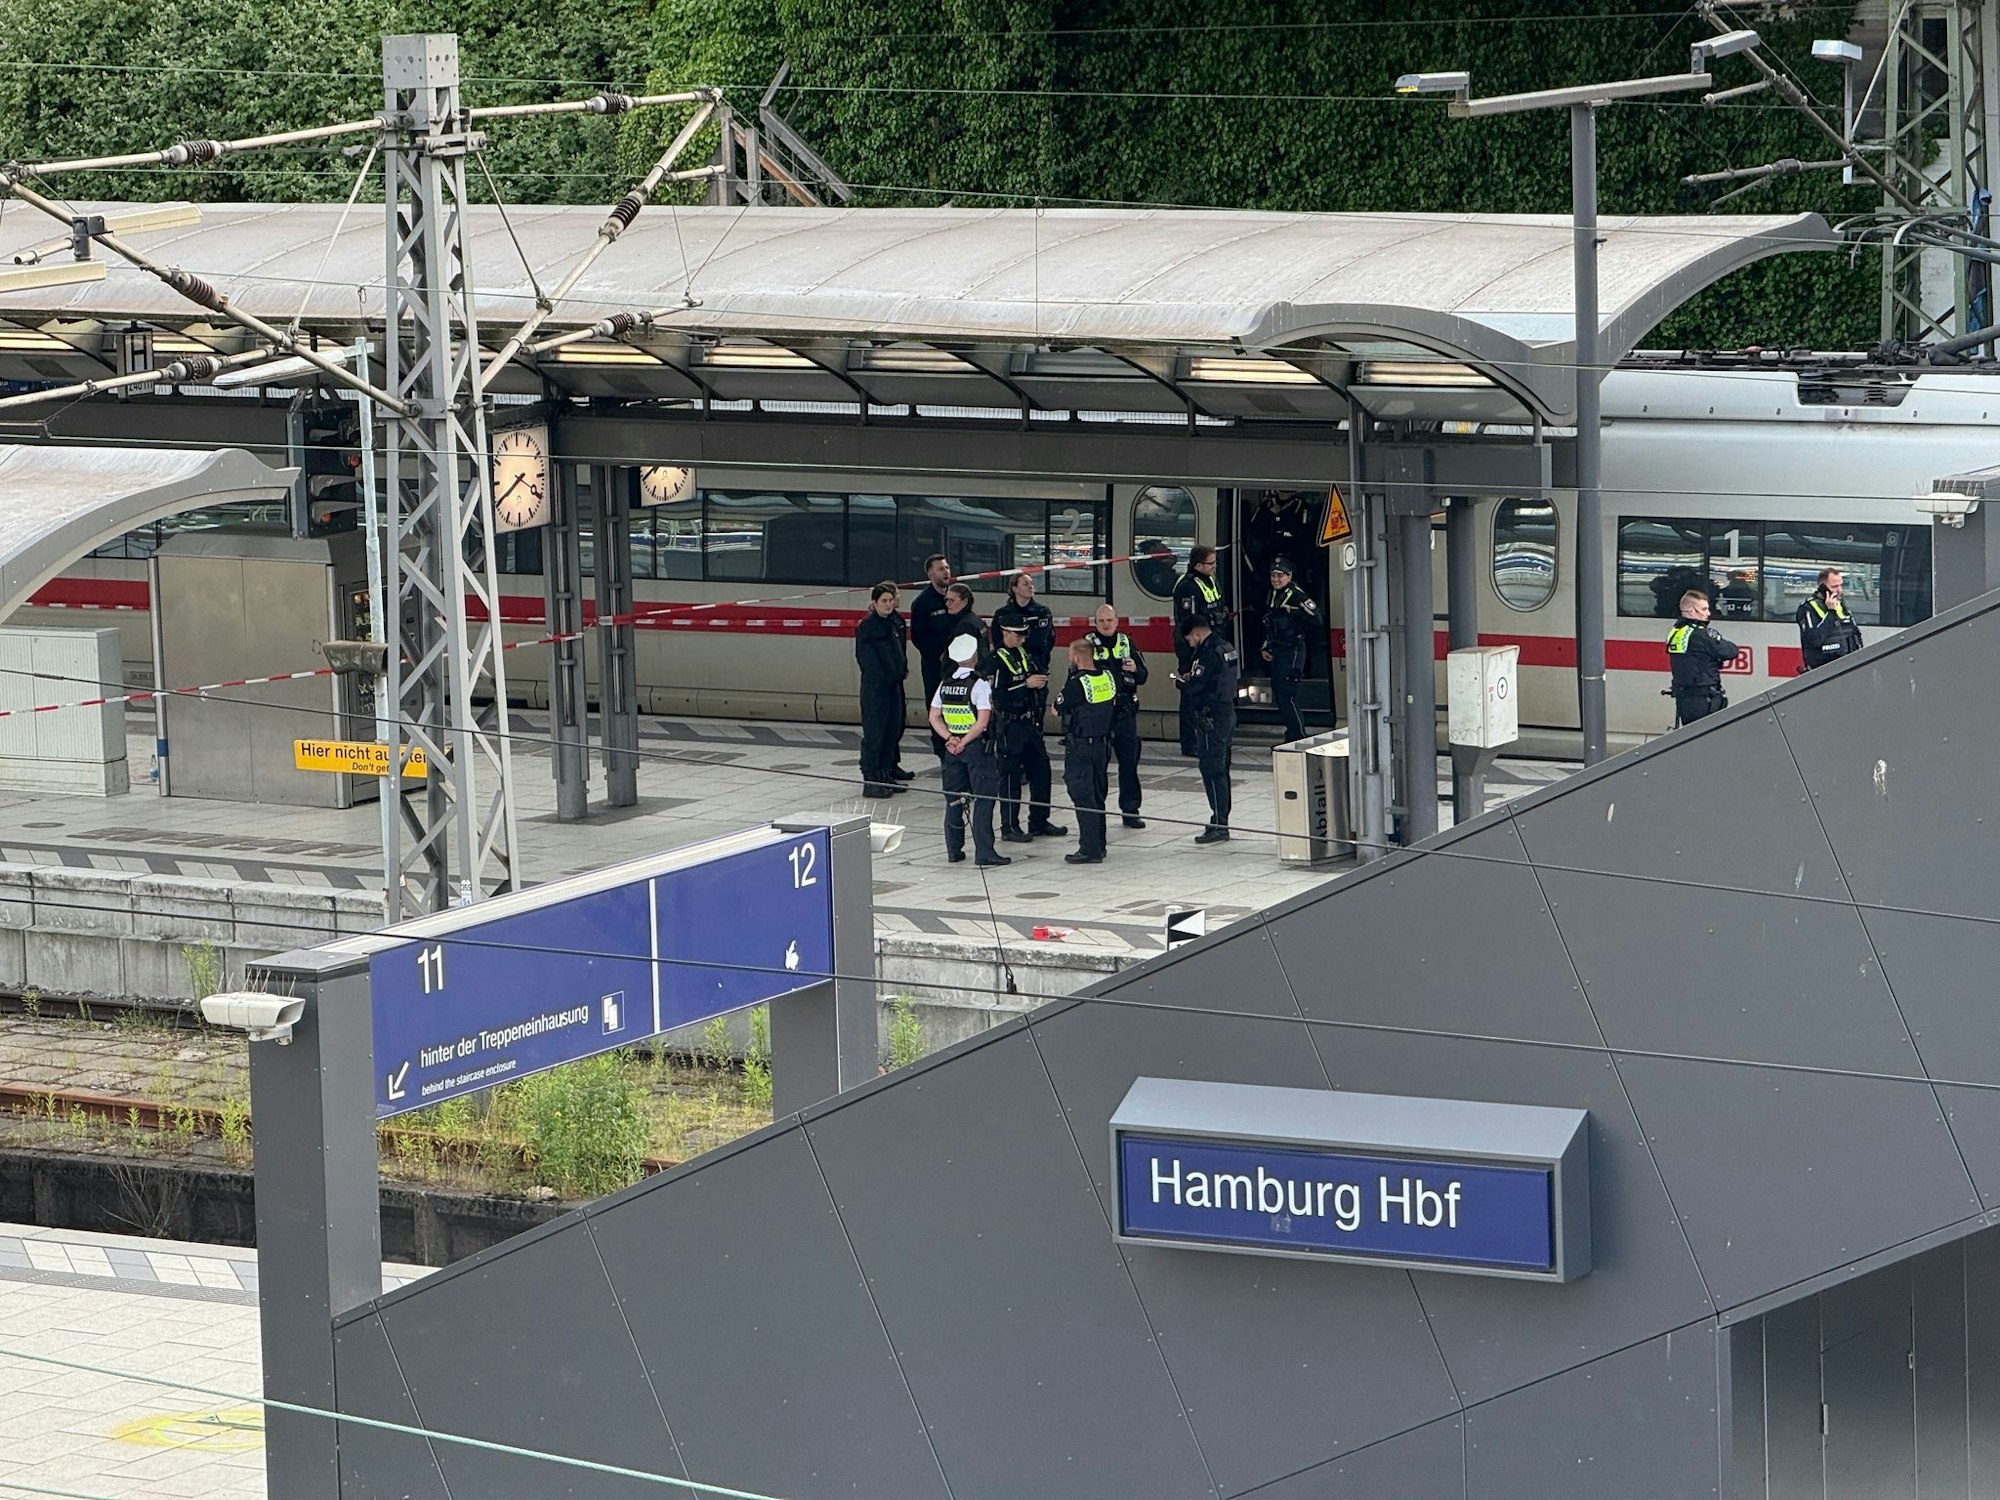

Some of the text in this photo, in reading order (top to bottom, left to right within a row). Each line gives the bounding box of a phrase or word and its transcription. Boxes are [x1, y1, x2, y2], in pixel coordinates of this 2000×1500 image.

[131, 335, 148, 371] H
[1062, 508, 1081, 543] 2
[1723, 528, 1744, 563] 1
[941, 686, 968, 695] POLIZEI
[301, 742, 331, 757] Hier
[335, 745, 371, 760] nicht
[352, 762, 374, 771] Don't
[1314, 784, 1327, 844] Abfall
[788, 842, 817, 889] 12
[417, 944, 444, 994] 11
[420, 1004, 589, 1068] hinter der Treppeneinhausung
[421, 1059, 517, 1097] behind the staircase enclosure
[1149, 1157, 1461, 1233] Hamburg Hbf
